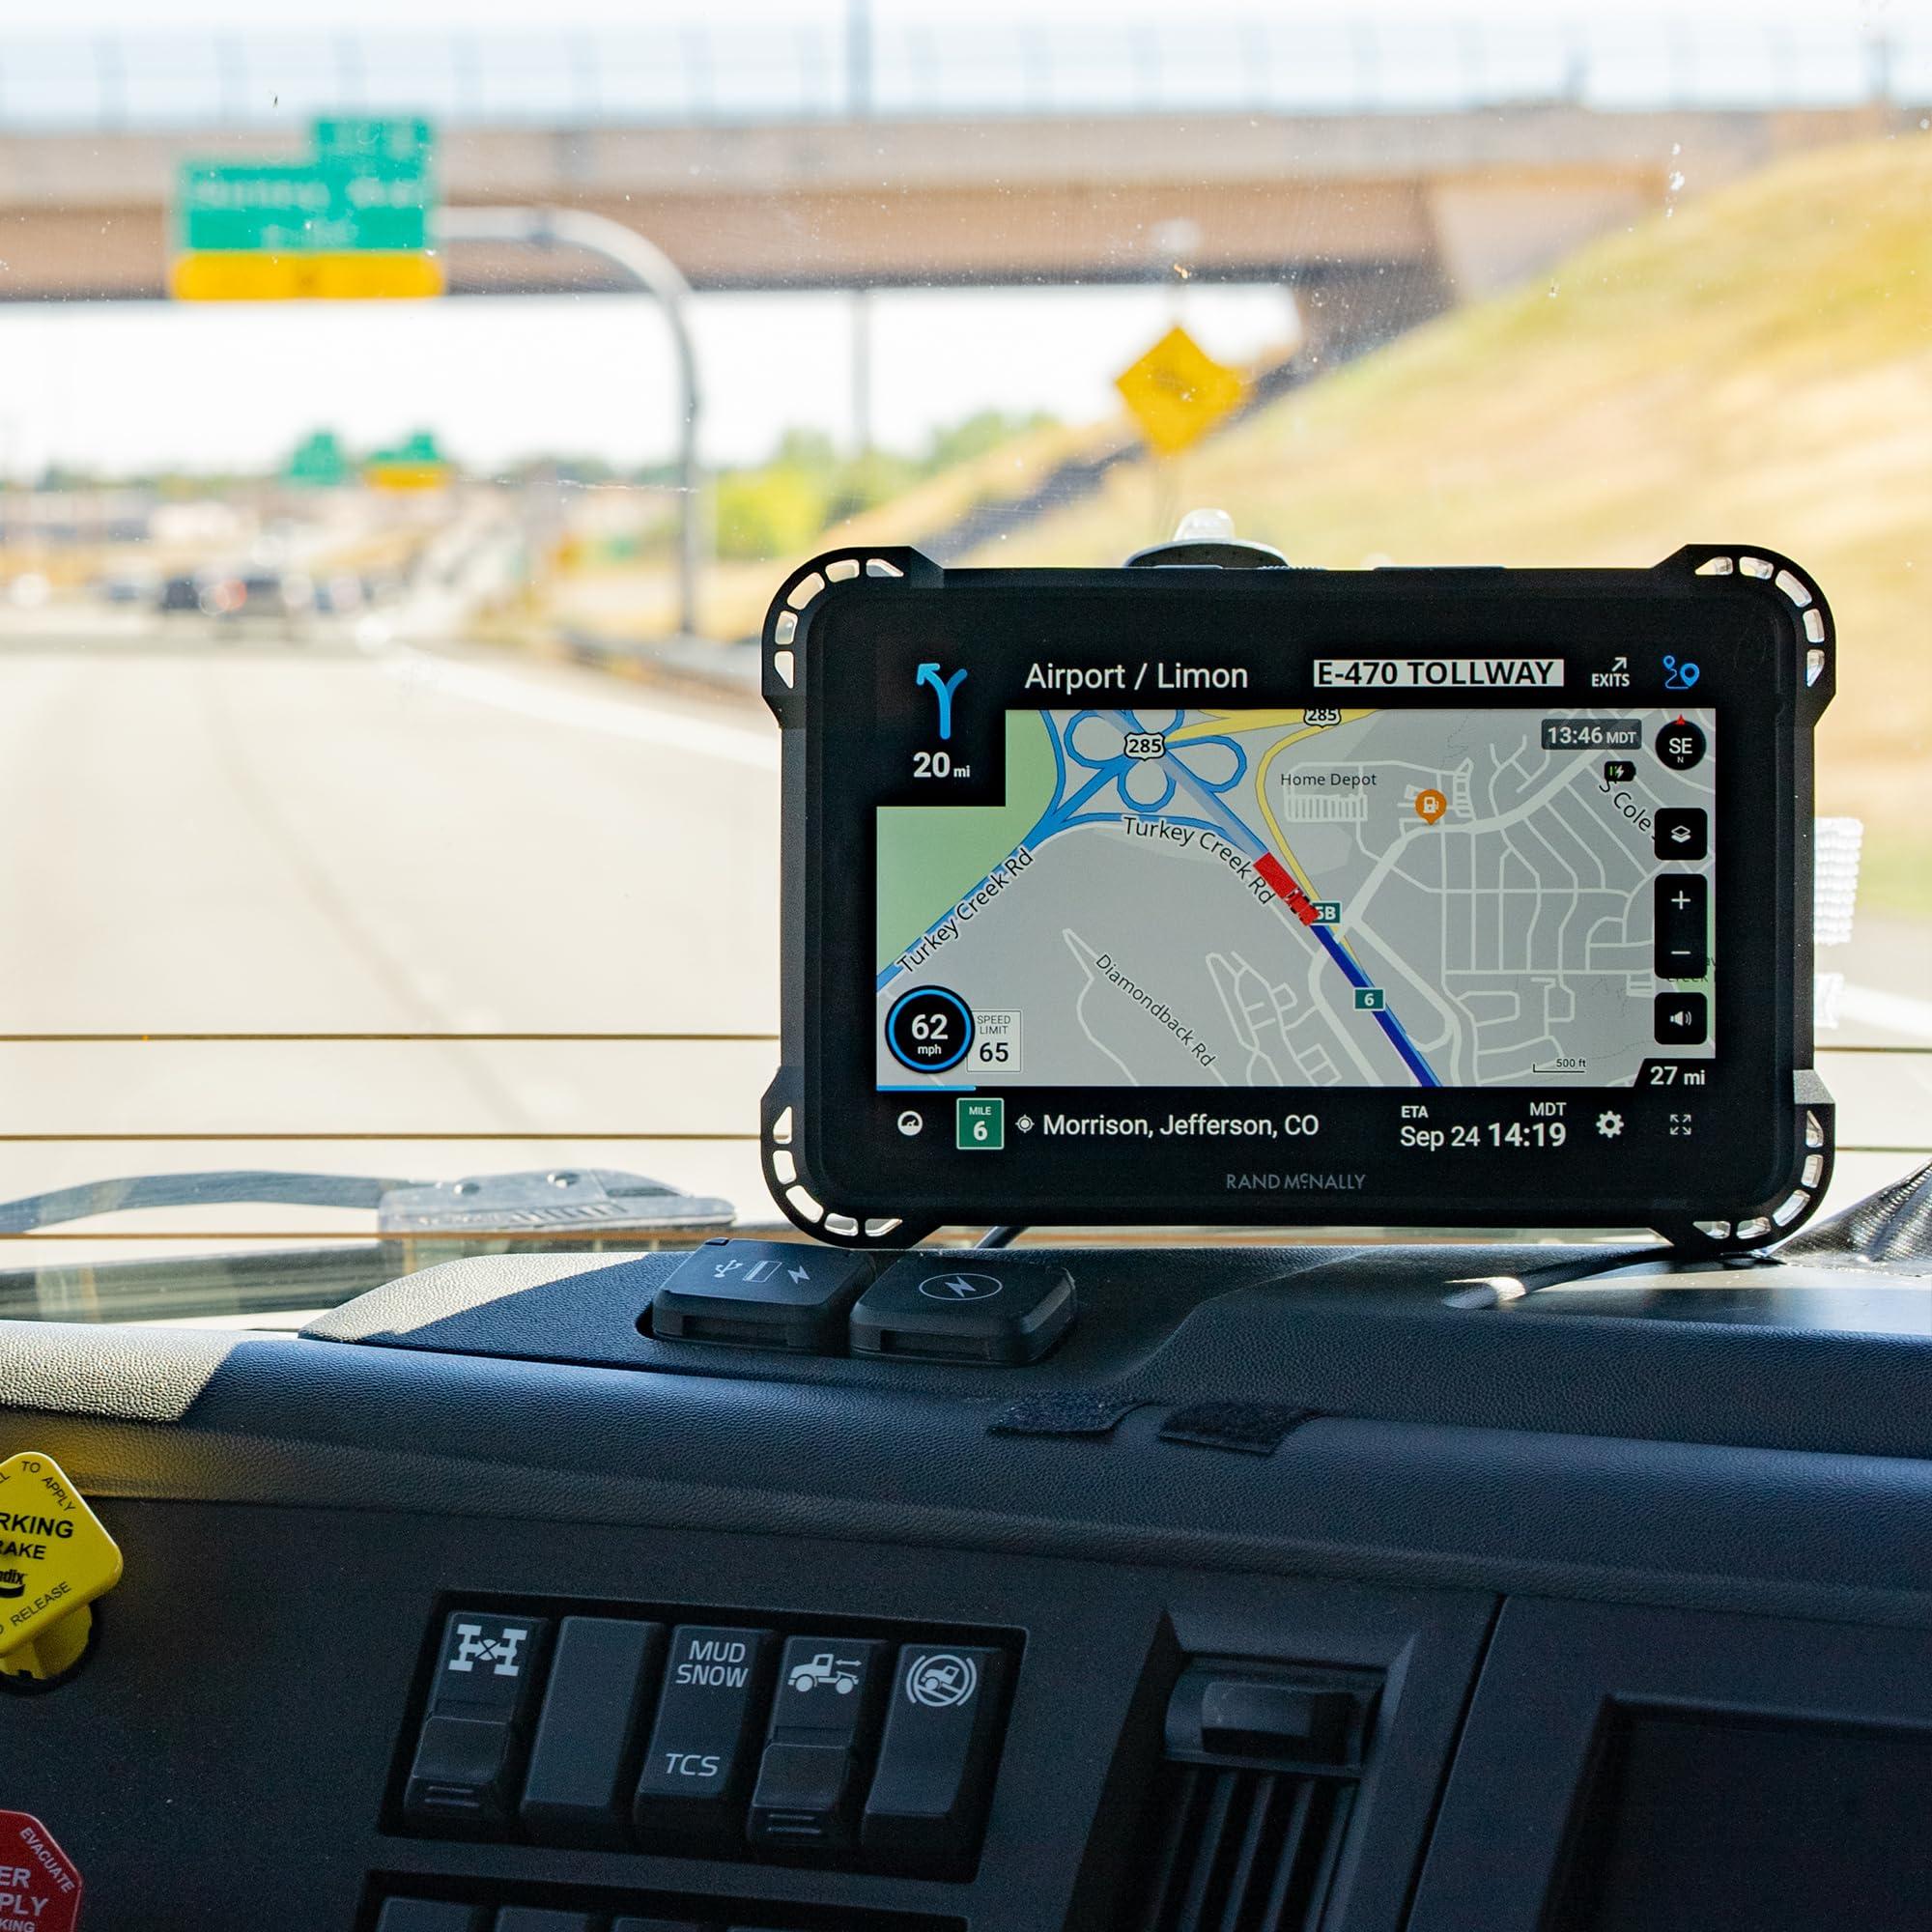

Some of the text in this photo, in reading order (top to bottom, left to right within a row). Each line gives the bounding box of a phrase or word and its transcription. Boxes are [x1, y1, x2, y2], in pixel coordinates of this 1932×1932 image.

[1024, 662, 1248, 696] Airport / Limon
[1318, 661, 1554, 686] E-470 TOLLWAY
[1591, 672, 1631, 688] EXITS
[1307, 708, 1338, 722] 285
[1128, 738, 1162, 753] 285
[1548, 726, 1637, 745] 13:46 MDT
[1668, 737, 1693, 754] SE
[913, 752, 971, 779] 20 mi
[1280, 773, 1378, 789] Home Depot
[1613, 791, 1652, 832] Cole
[1122, 816, 1276, 905] Turkey Creek Rd
[895, 847, 1035, 973] Turkey Creek Rd
[1095, 953, 1217, 1067] Diamondback Rd
[1364, 992, 1376, 1007] 6
[911, 1013, 950, 1040] 62
[977, 1014, 1011, 1025] SPEED
[979, 1025, 1009, 1036] LIMIT
[917, 1043, 943, 1058] mph
[979, 1041, 1009, 1064] 65
[1555, 1058, 1587, 1068] 500 ft
[1649, 1065, 1706, 1086] 27 mi
[968, 1106, 992, 1116] MILE
[1400, 1105, 1430, 1119] ETA
[1529, 1102, 1567, 1117] MDT
[972, 1120, 988, 1142] 6
[1042, 1113, 1320, 1139] Morrison, Jefferson, CO
[1400, 1122, 1567, 1151] Sep 24 14:19
[1226, 1174, 1281, 1190] RAND
[21, 1461, 76, 1513] TO APPLY
[10, 1580, 72, 1628] RELEASE
[689, 1640, 747, 1663] MUD
[675, 1663, 750, 1688] SNOW
[665, 1752, 722, 1777] TCS
[19, 1826, 76, 1894] EVACUATE
